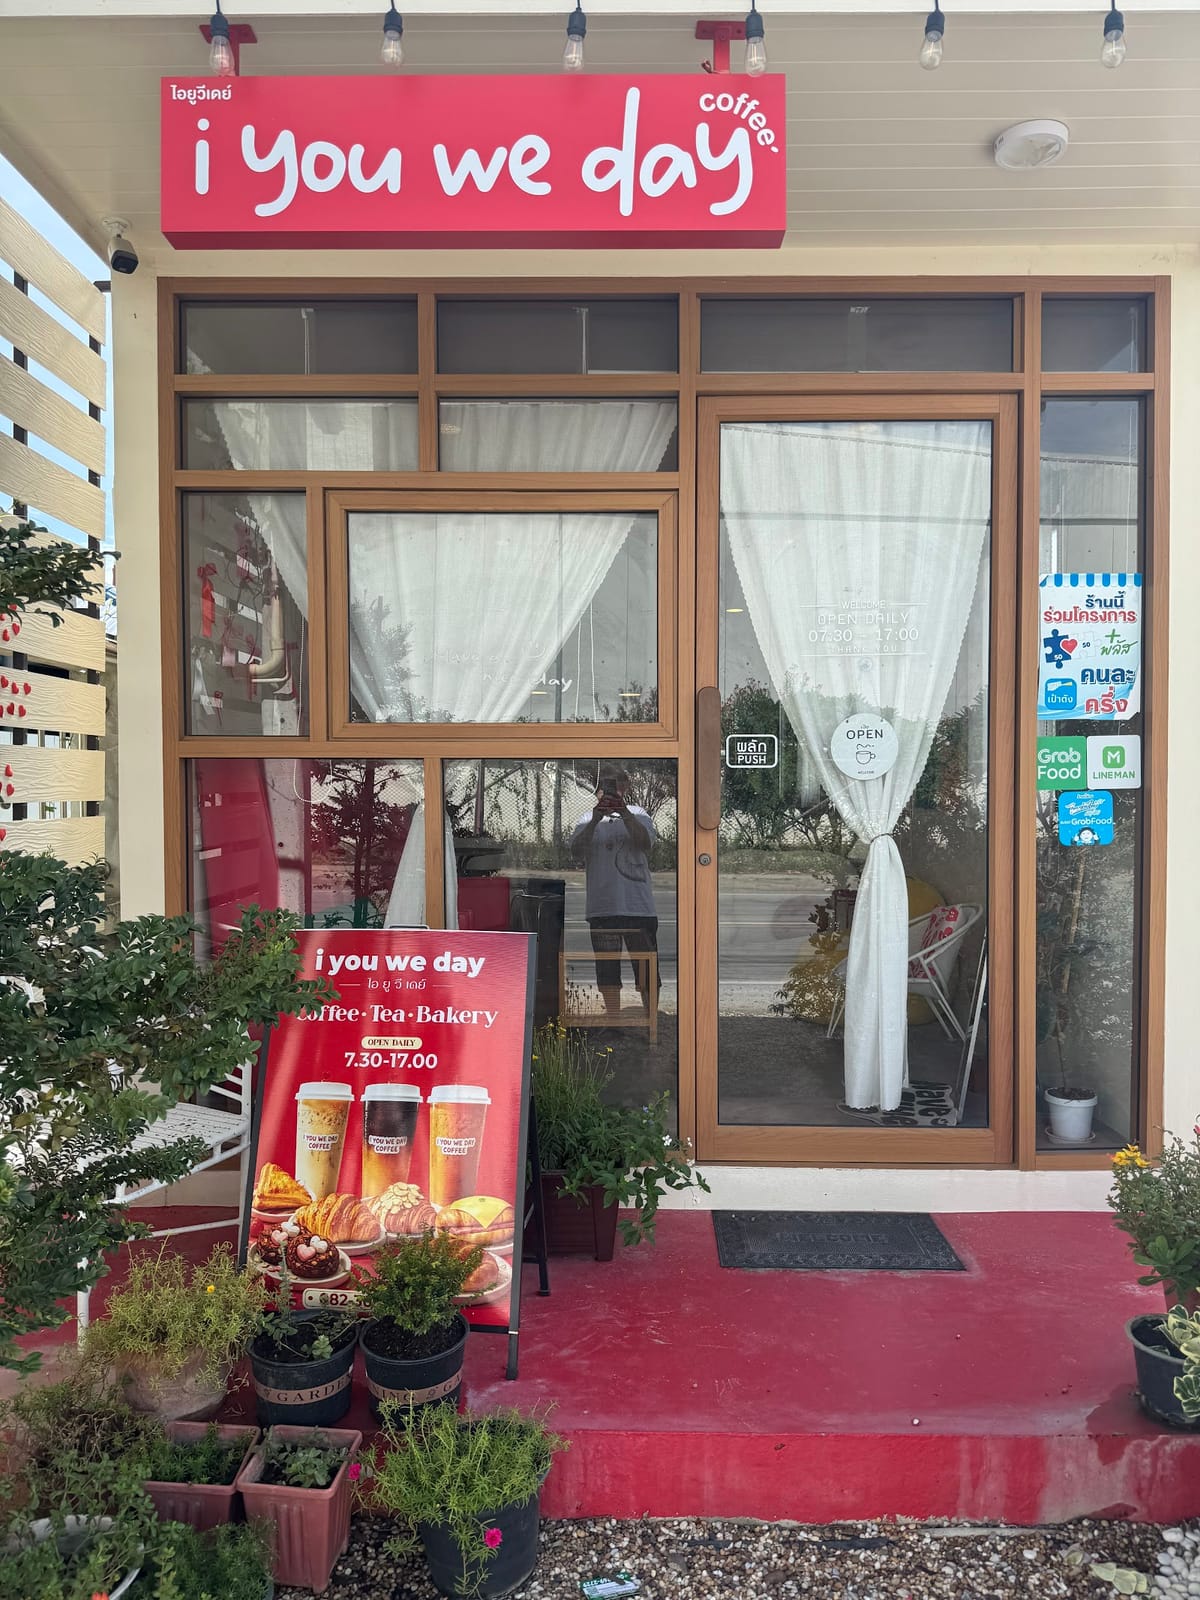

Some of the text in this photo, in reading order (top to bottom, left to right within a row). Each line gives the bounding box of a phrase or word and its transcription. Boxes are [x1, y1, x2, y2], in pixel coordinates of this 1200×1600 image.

[169, 84, 232, 106] ไอยูวีเดย์
[195, 86, 754, 217] i you we day
[840, 599, 887, 610] WELCOME
[1085, 591, 1125, 608] ร้านนี้
[817, 612, 910, 625] OPEN DAILY
[1043, 606, 1137, 623] ร่วมโครงการ
[808, 628, 853, 642] 07:30
[875, 627, 919, 641] 17:00
[1080, 667, 1135, 684] คนละ
[1085, 686, 1129, 714] ครึ่ง
[846, 728, 884, 740] OPEN
[737, 739, 767, 753] ผลัก
[737, 755, 767, 765] PUSH
[1037, 747, 1081, 764] Grab
[1037, 764, 1081, 780] Food
[1071, 816, 1113, 826] GrabFood
[315, 947, 486, 977] i you we day
[367, 977, 379, 989] ไอ
[382, 980, 391, 993] ยู
[406, 978, 427, 990] เดย์
[367, 1038, 416, 1047] OPEN DAILY
[344, 1052, 438, 1069] 7.30-17.00
[308, 1142, 330, 1150] COFFEE
[396, 1137, 407, 1145] DAY
[375, 1145, 398, 1153] COFFEE
[442, 1146, 466, 1154] COFFEE
